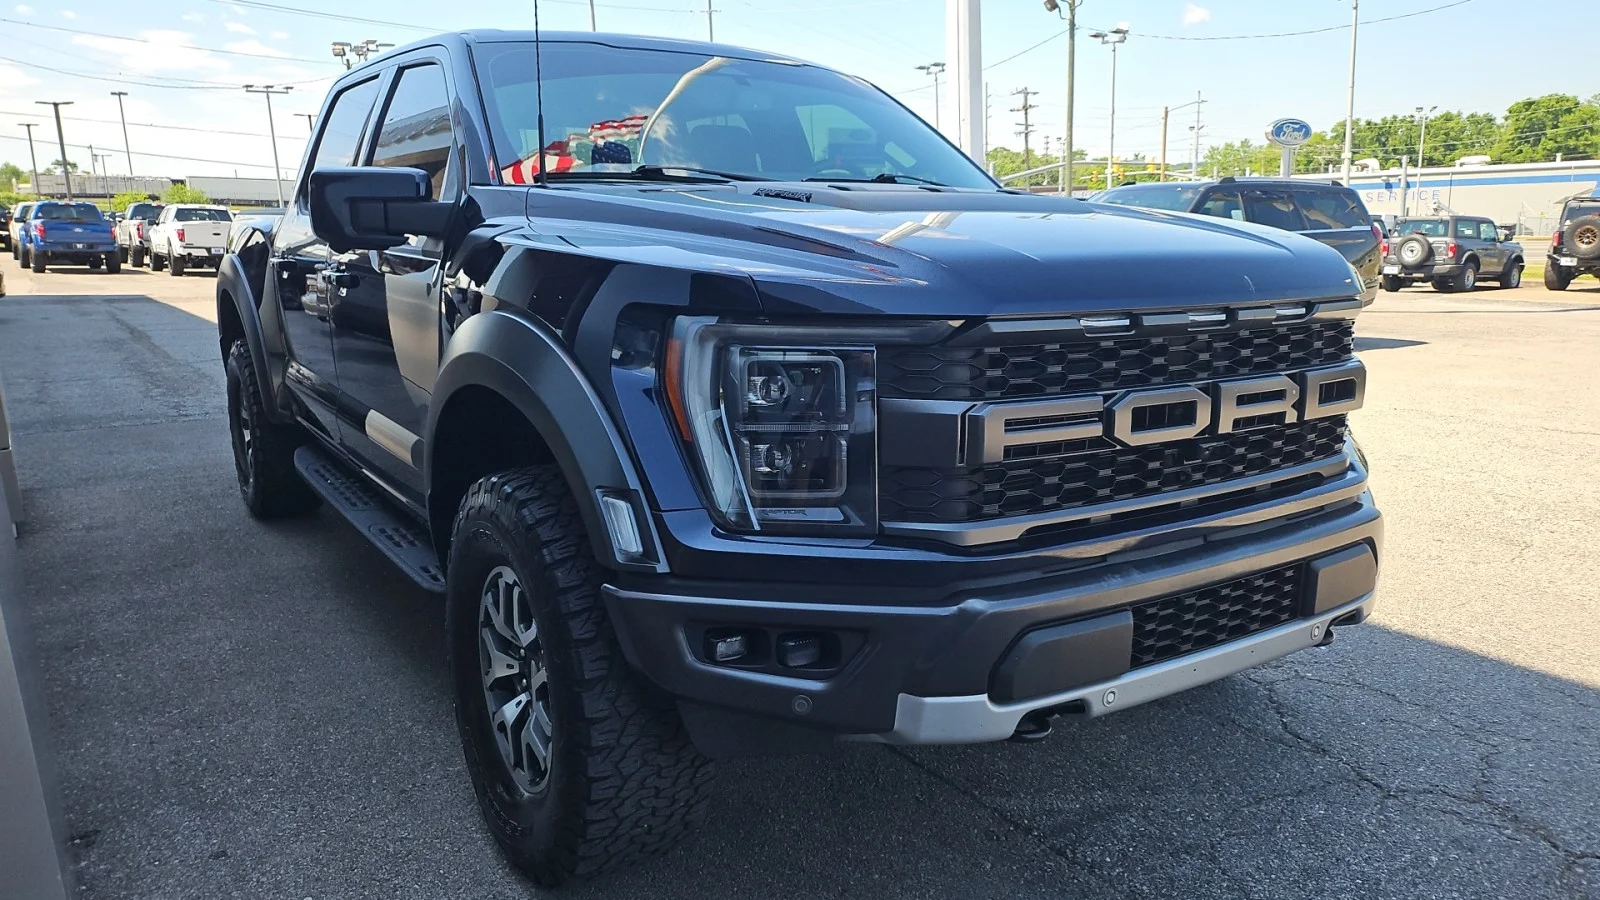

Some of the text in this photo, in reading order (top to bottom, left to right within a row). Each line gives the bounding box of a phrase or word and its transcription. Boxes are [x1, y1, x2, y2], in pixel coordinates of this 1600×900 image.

[1280, 123, 1306, 140] Ford
[754, 187, 813, 202] RAPTOR
[1365, 189, 1441, 203] SERICE
[970, 360, 1367, 465] FORD
